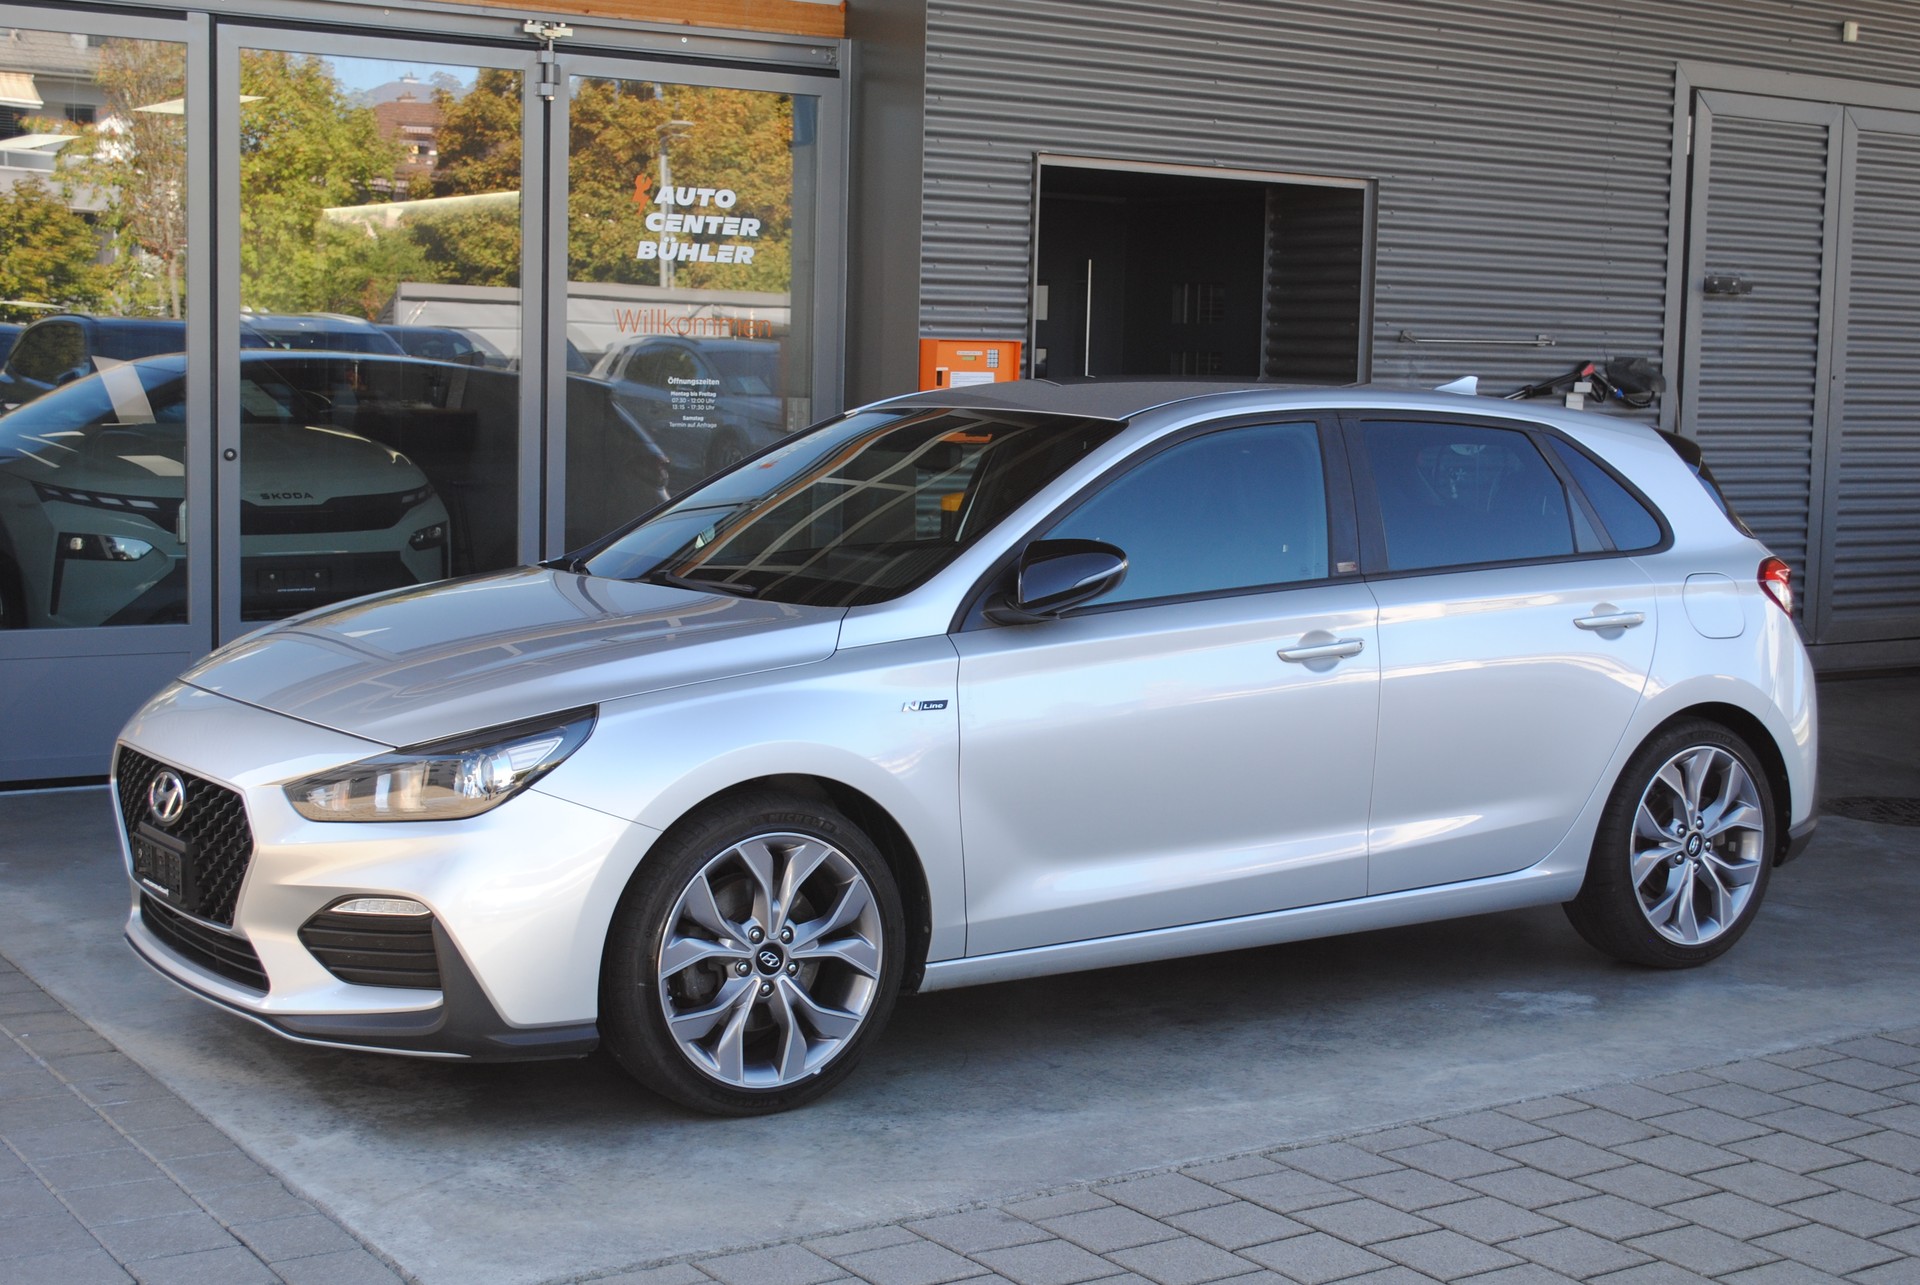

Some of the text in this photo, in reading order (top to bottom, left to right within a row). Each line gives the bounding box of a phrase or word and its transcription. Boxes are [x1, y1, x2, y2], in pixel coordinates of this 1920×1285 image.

[654, 186, 737, 208] AUTO
[645, 213, 761, 236] CENTER
[636, 237, 755, 264] BÜHLER
[616, 308, 772, 337] Willkommen
[668, 376, 720, 386] Öffnungszeiten
